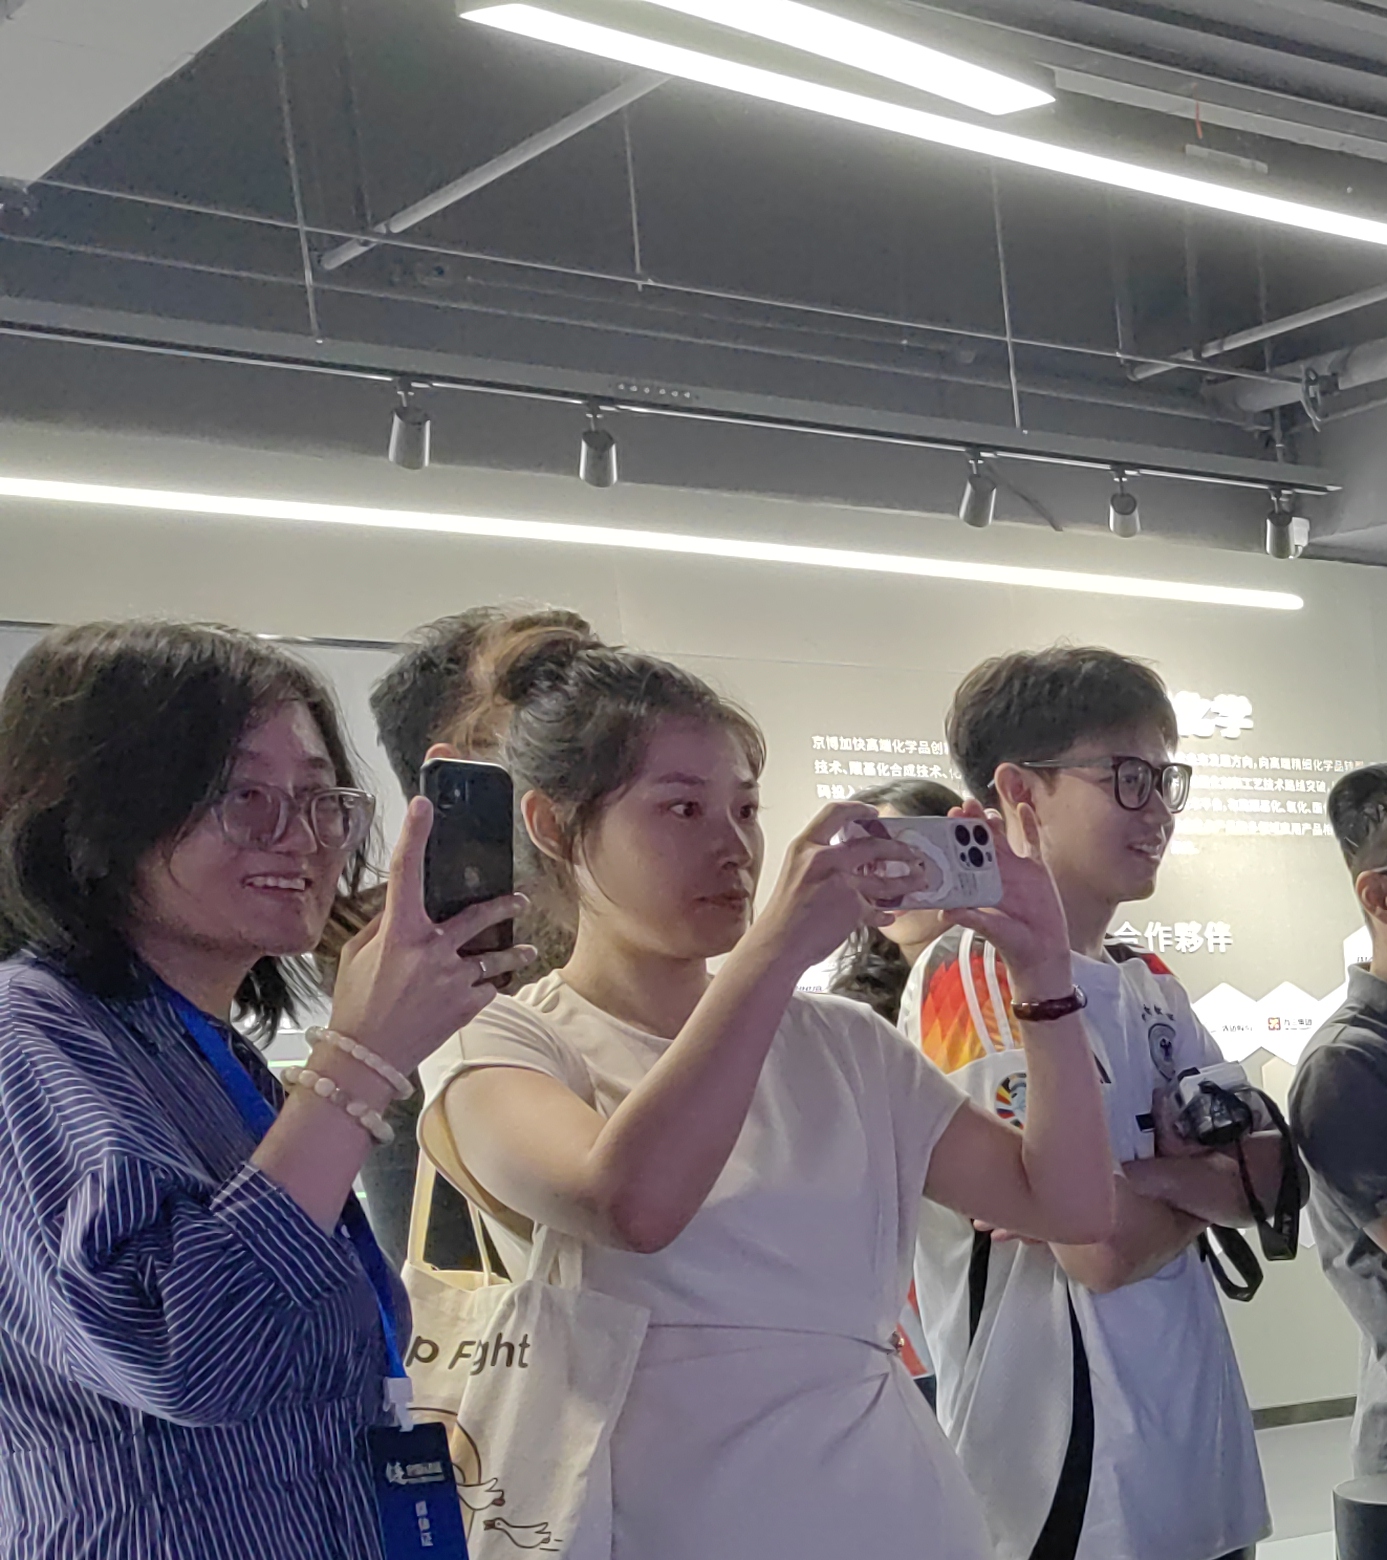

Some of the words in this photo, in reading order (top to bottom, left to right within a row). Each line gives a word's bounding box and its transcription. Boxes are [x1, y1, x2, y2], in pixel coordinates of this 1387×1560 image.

[1166, 690, 1254, 739] 化学
[812, 735, 949, 756] 京博加快高端化学品创
